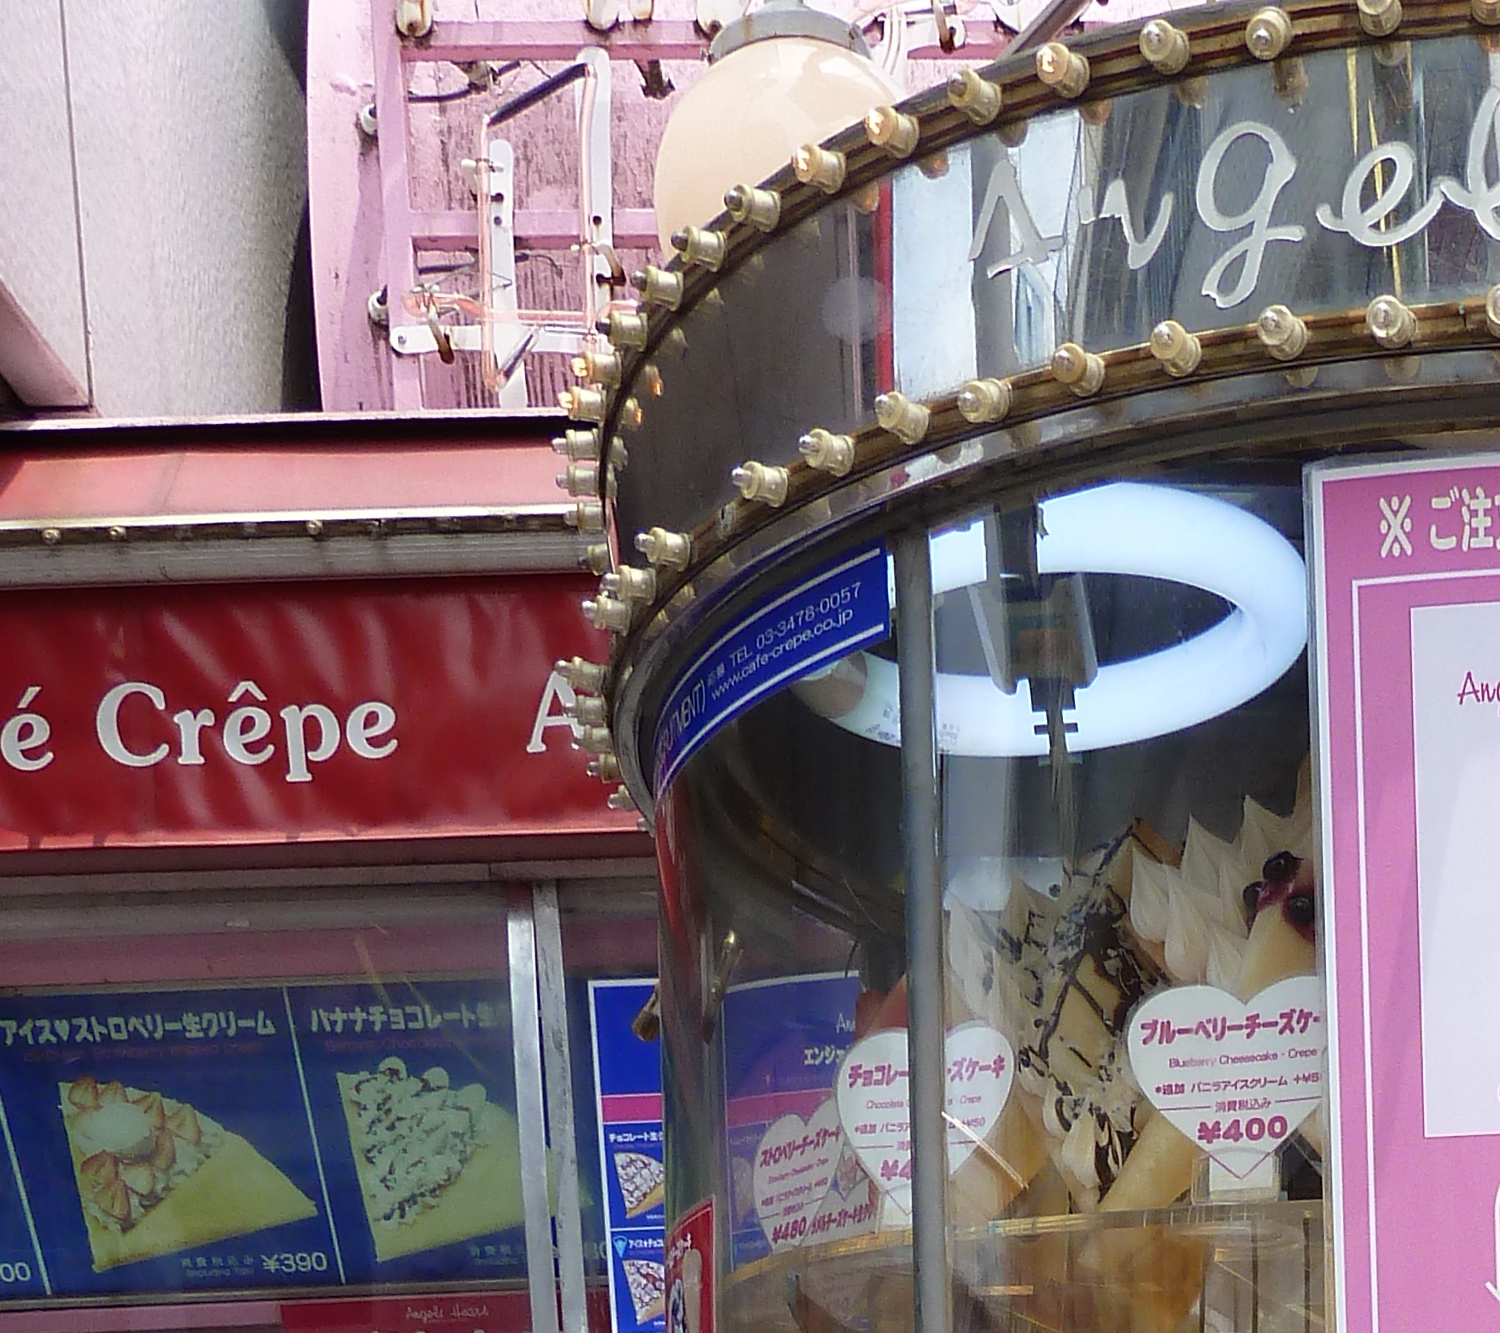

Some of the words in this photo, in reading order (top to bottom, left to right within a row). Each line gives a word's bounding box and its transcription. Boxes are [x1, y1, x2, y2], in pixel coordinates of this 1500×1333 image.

[710, 607, 855, 701] www.cafe-crepe.co.jp
[730, 643, 753, 668] TEL
[96, 680, 399, 782] Crêpe
[1218, 1051, 1279, 1066] Cheesecake
[1287, 1047, 1318, 1060] Crepe
[1190, 1075, 1289, 1094] バニラアイスクリーム
[1214, 1096, 1272, 1114] 消費税込み
[1197, 1114, 1289, 1145] ¥400
[261, 1250, 328, 1275] ¥390
